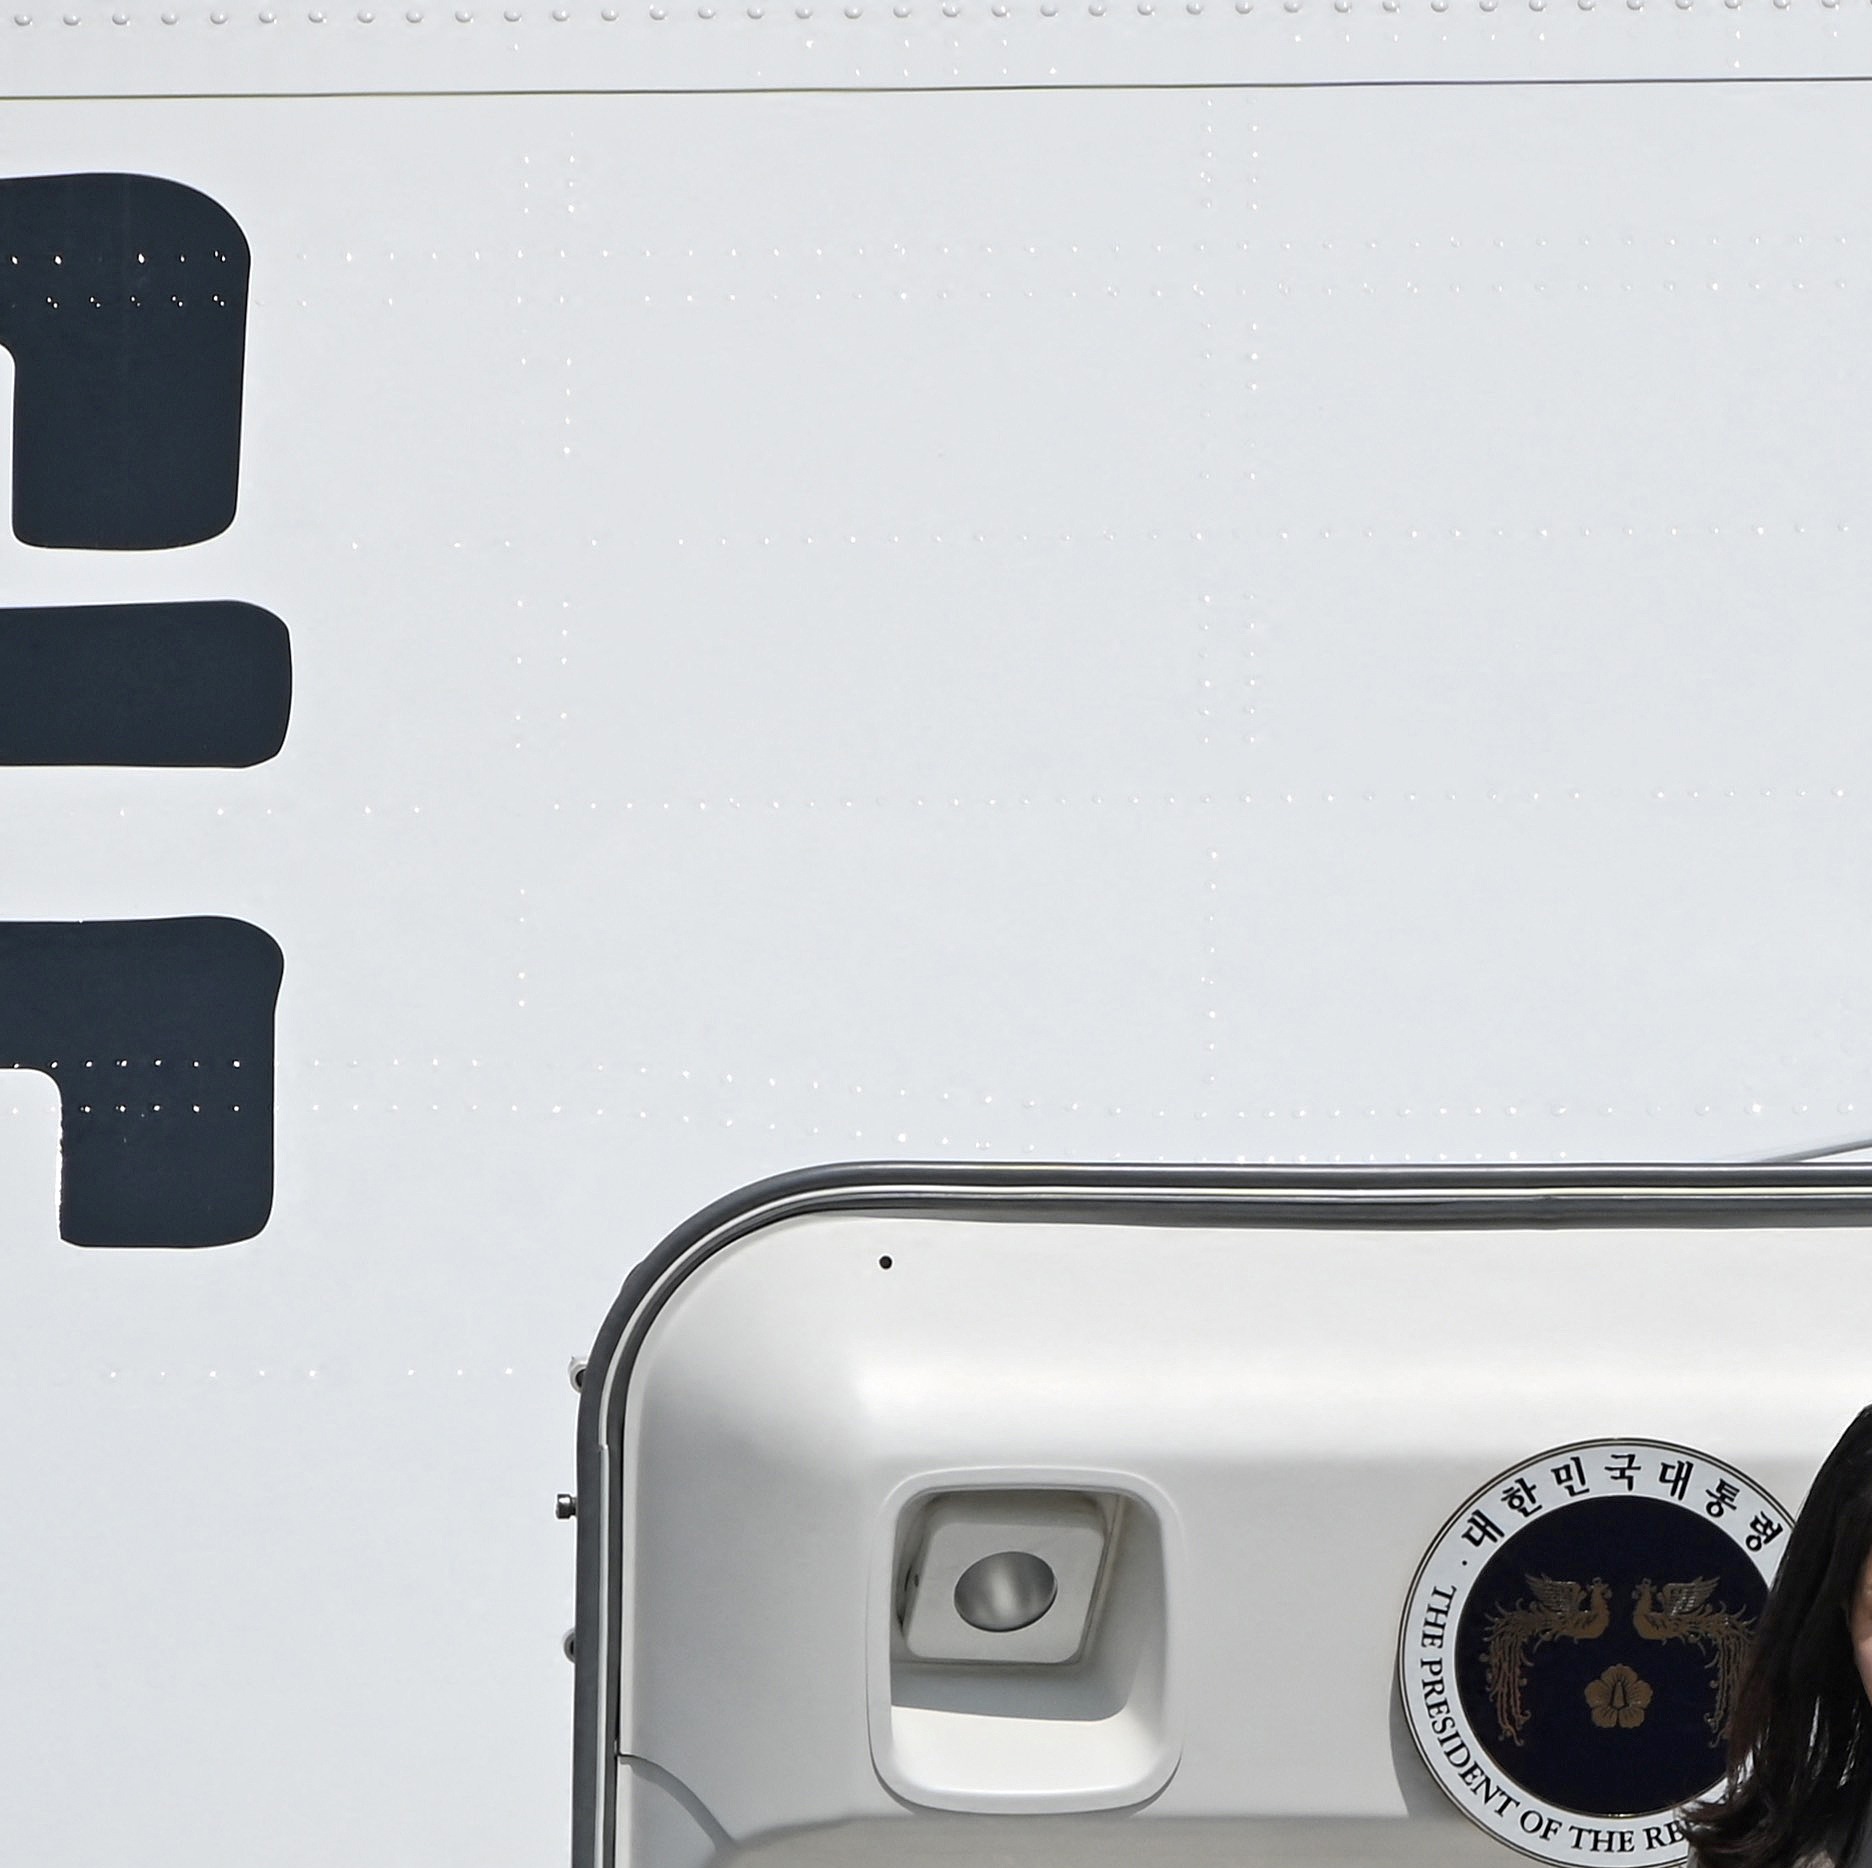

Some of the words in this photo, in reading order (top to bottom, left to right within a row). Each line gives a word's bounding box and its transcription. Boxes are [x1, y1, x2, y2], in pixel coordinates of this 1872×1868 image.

[1420, 1584, 1458, 1650] THE
[1420, 1656, 1521, 1818] PRESIDENT
[1519, 1809, 1563, 1842] OF
[1568, 1824, 1636, 1853] THE
